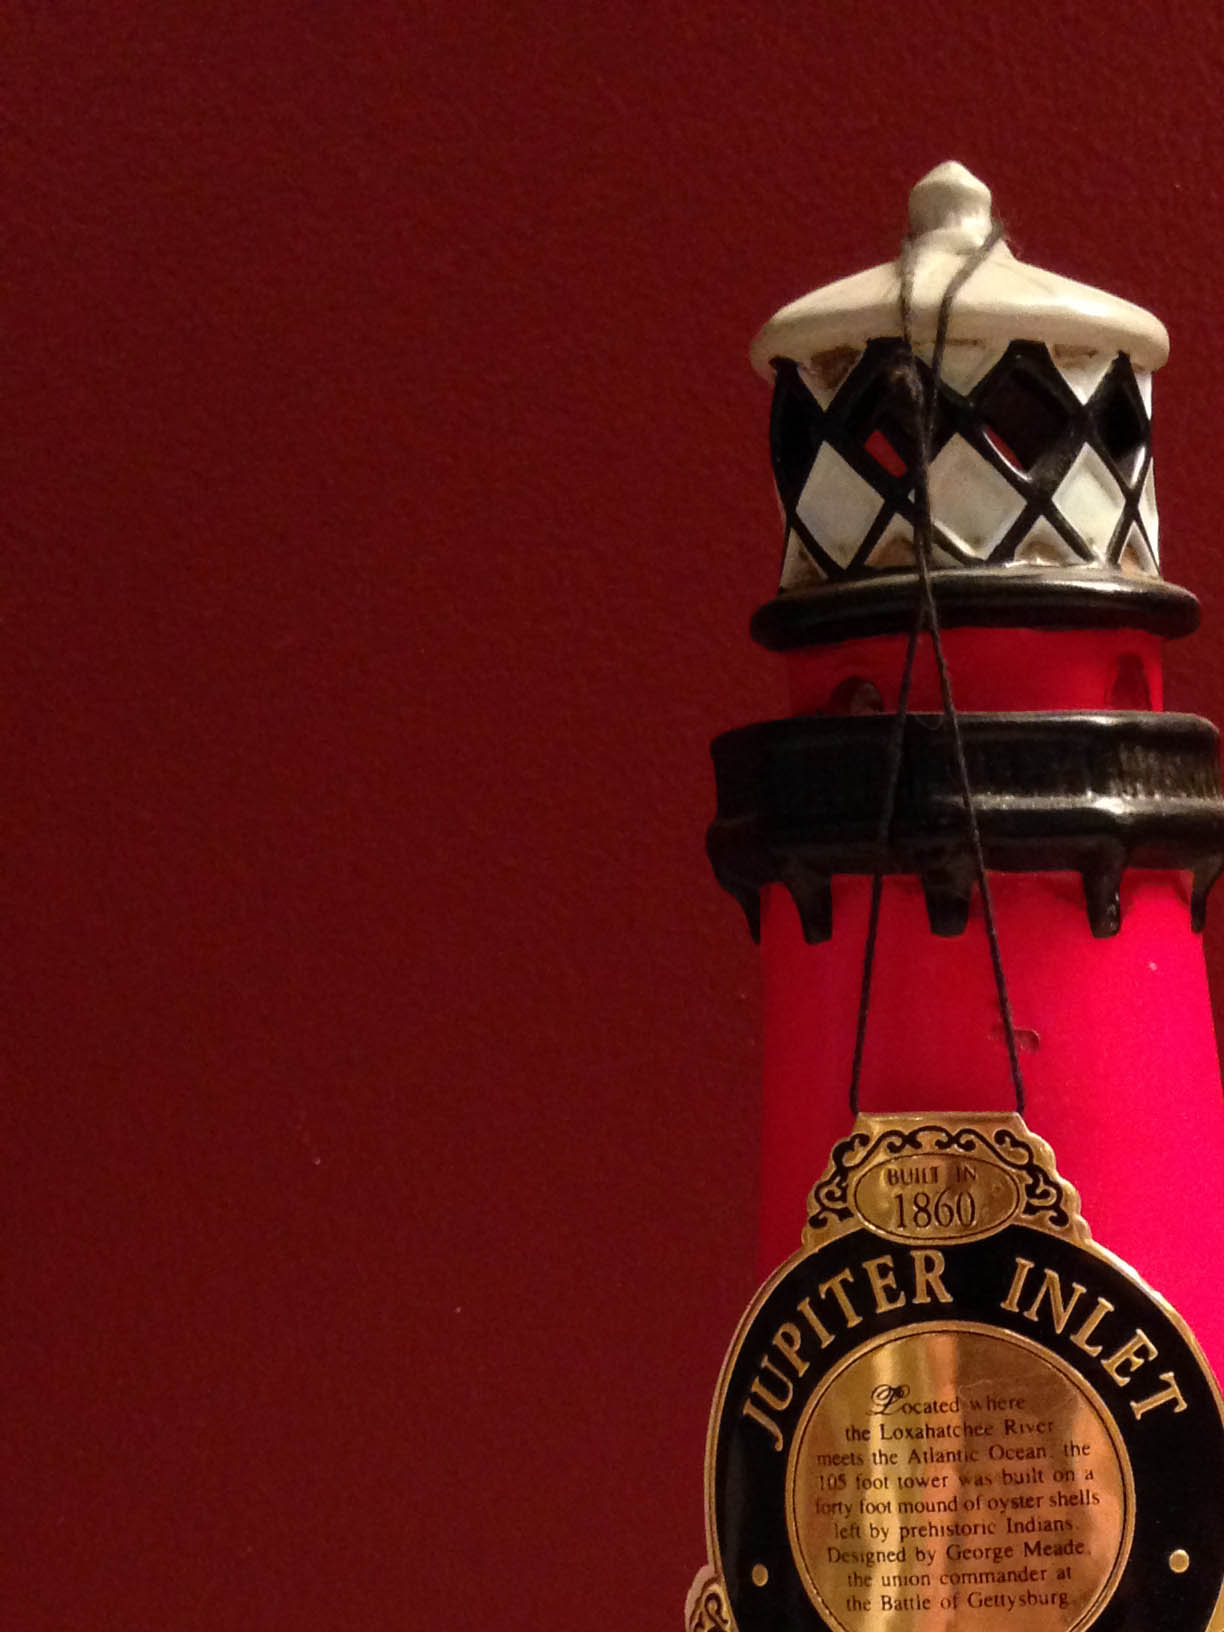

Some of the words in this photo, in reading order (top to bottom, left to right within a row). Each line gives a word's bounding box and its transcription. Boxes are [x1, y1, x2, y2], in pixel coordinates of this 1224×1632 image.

[886, 1167, 942, 1186] BUILT
[956, 1166, 977, 1181] IN
[895, 1191, 976, 1230] 1860
[742, 1248, 953, 1451] JUPITER
[1001, 1256, 1188, 1420] INLET
[866, 1384, 959, 1415] Located
[970, 1397, 1024, 1411] where
[846, 1426, 870, 1441] the
[880, 1423, 993, 1441] Loxahatchee
[1004, 1419, 1053, 1434] River
[817, 1452, 864, 1466] meets
[872, 1450, 897, 1465] the
[908, 1448, 978, 1464] Atlantic
[1063, 1442, 1091, 1456] the
[818, 1474, 846, 1490] 105
[856, 1472, 889, 1489] foot
[898, 1473, 948, 1488] tower
[958, 1473, 992, 1486] was
[1002, 1467, 1044, 1485] built
[1053, 1470, 1075, 1482] on
[1085, 1469, 1093, 1481] a
[816, 1499, 852, 1516] forty
[859, 1496, 892, 1514] foot
[899, 1496, 958, 1513] mound
[964, 1494, 983, 1511] of
[987, 1493, 1044, 1513] oyster
[1049, 1489, 1100, 1507] shells
[835, 1522, 860, 1539] left
[870, 1520, 889, 1542] by
[900, 1516, 994, 1541] prehistoric
[828, 1545, 907, 1566] Designed
[916, 1543, 935, 1565] by
[946, 1543, 1013, 1563] George
[848, 1572, 872, 1588] the
[882, 1571, 930, 1586] union
[940, 1566, 1046, 1584] commander
[1056, 1566, 1071, 1580] at
[846, 1596, 871, 1612] the
[881, 1594, 931, 1611] Battle
[940, 1594, 959, 1609] of
